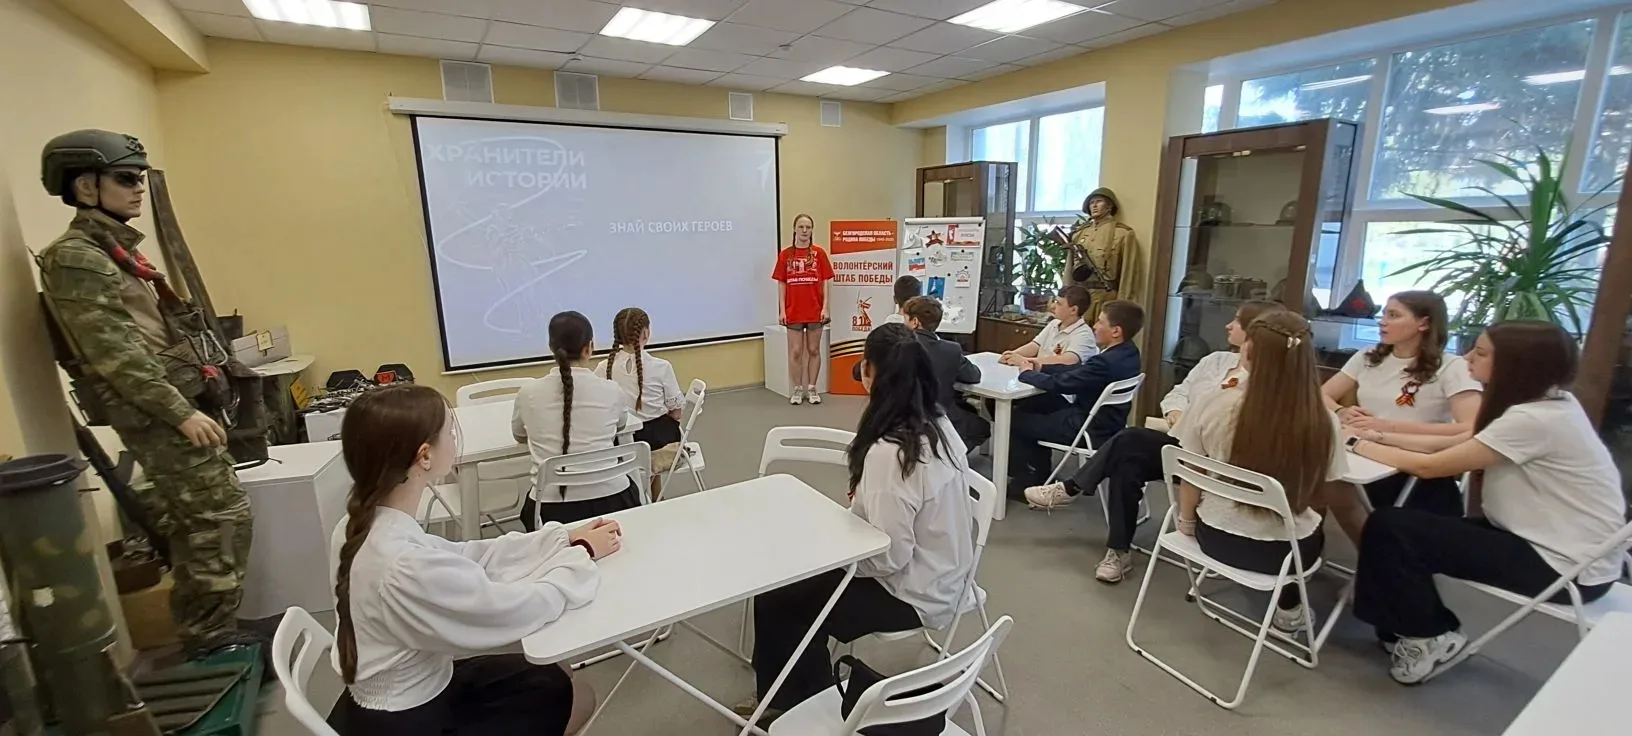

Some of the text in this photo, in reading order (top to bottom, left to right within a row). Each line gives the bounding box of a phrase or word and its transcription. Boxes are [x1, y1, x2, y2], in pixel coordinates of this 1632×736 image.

[426, 143, 586, 167] ХРАНИТЕЛИ
[467, 169, 587, 189] ИСТОРИИ
[610, 218, 733, 234] ЗНАЙ СВОИХ ГЕРОЕВ
[833, 261, 893, 270] ВОЛОНТЁРСКИЙ
[833, 274, 893, 284] ШТАБ ПОБЕДЫ
